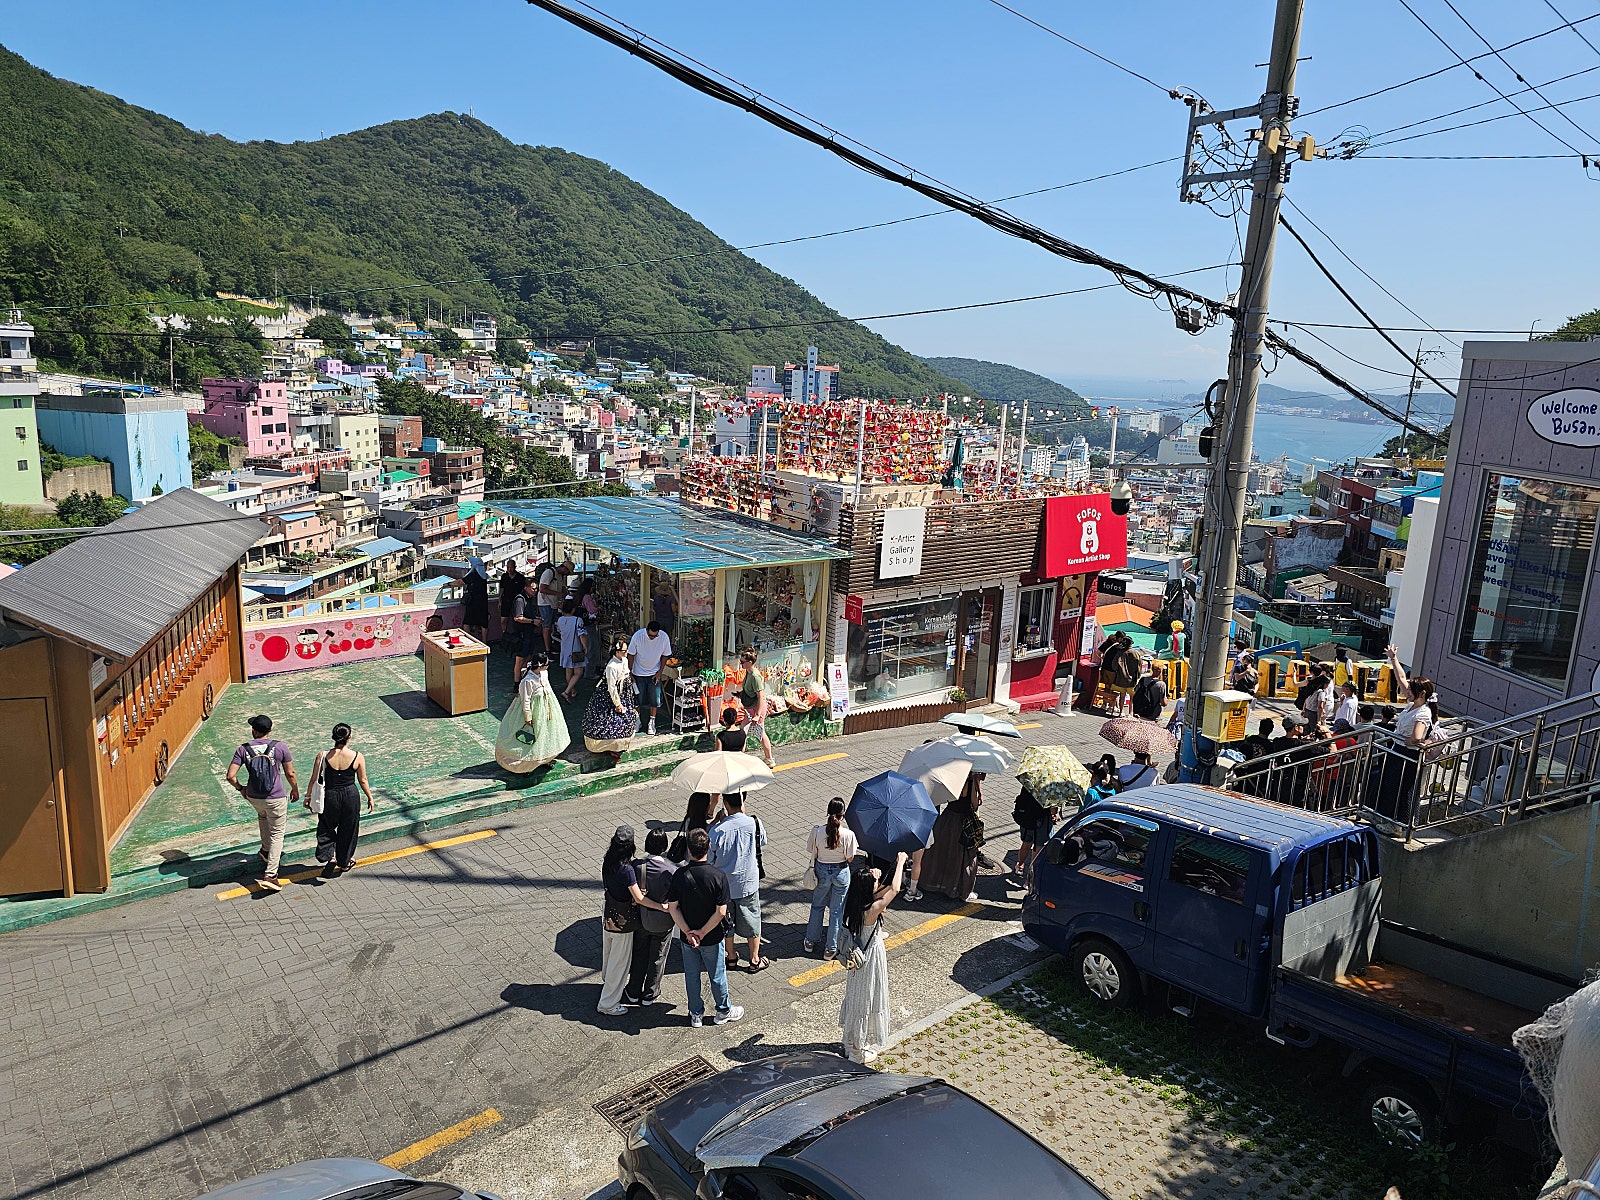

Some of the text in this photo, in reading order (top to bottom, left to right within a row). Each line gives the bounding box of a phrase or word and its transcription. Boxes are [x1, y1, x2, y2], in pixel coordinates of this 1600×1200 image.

[1541, 397, 1598, 415] Welcome
[1076, 507, 1102, 523] FOFOS
[889, 545, 915, 555] Gallery
[888, 556, 914, 566] Shop
[1067, 553, 1111, 566] Korean Artist Shop
[1519, 560, 1540, 572] like
[1102, 581, 1122, 592] fofos
[1510, 581, 1522, 591] as
[1524, 584, 1561, 603] honey.
[924, 616, 942, 624] Korean
